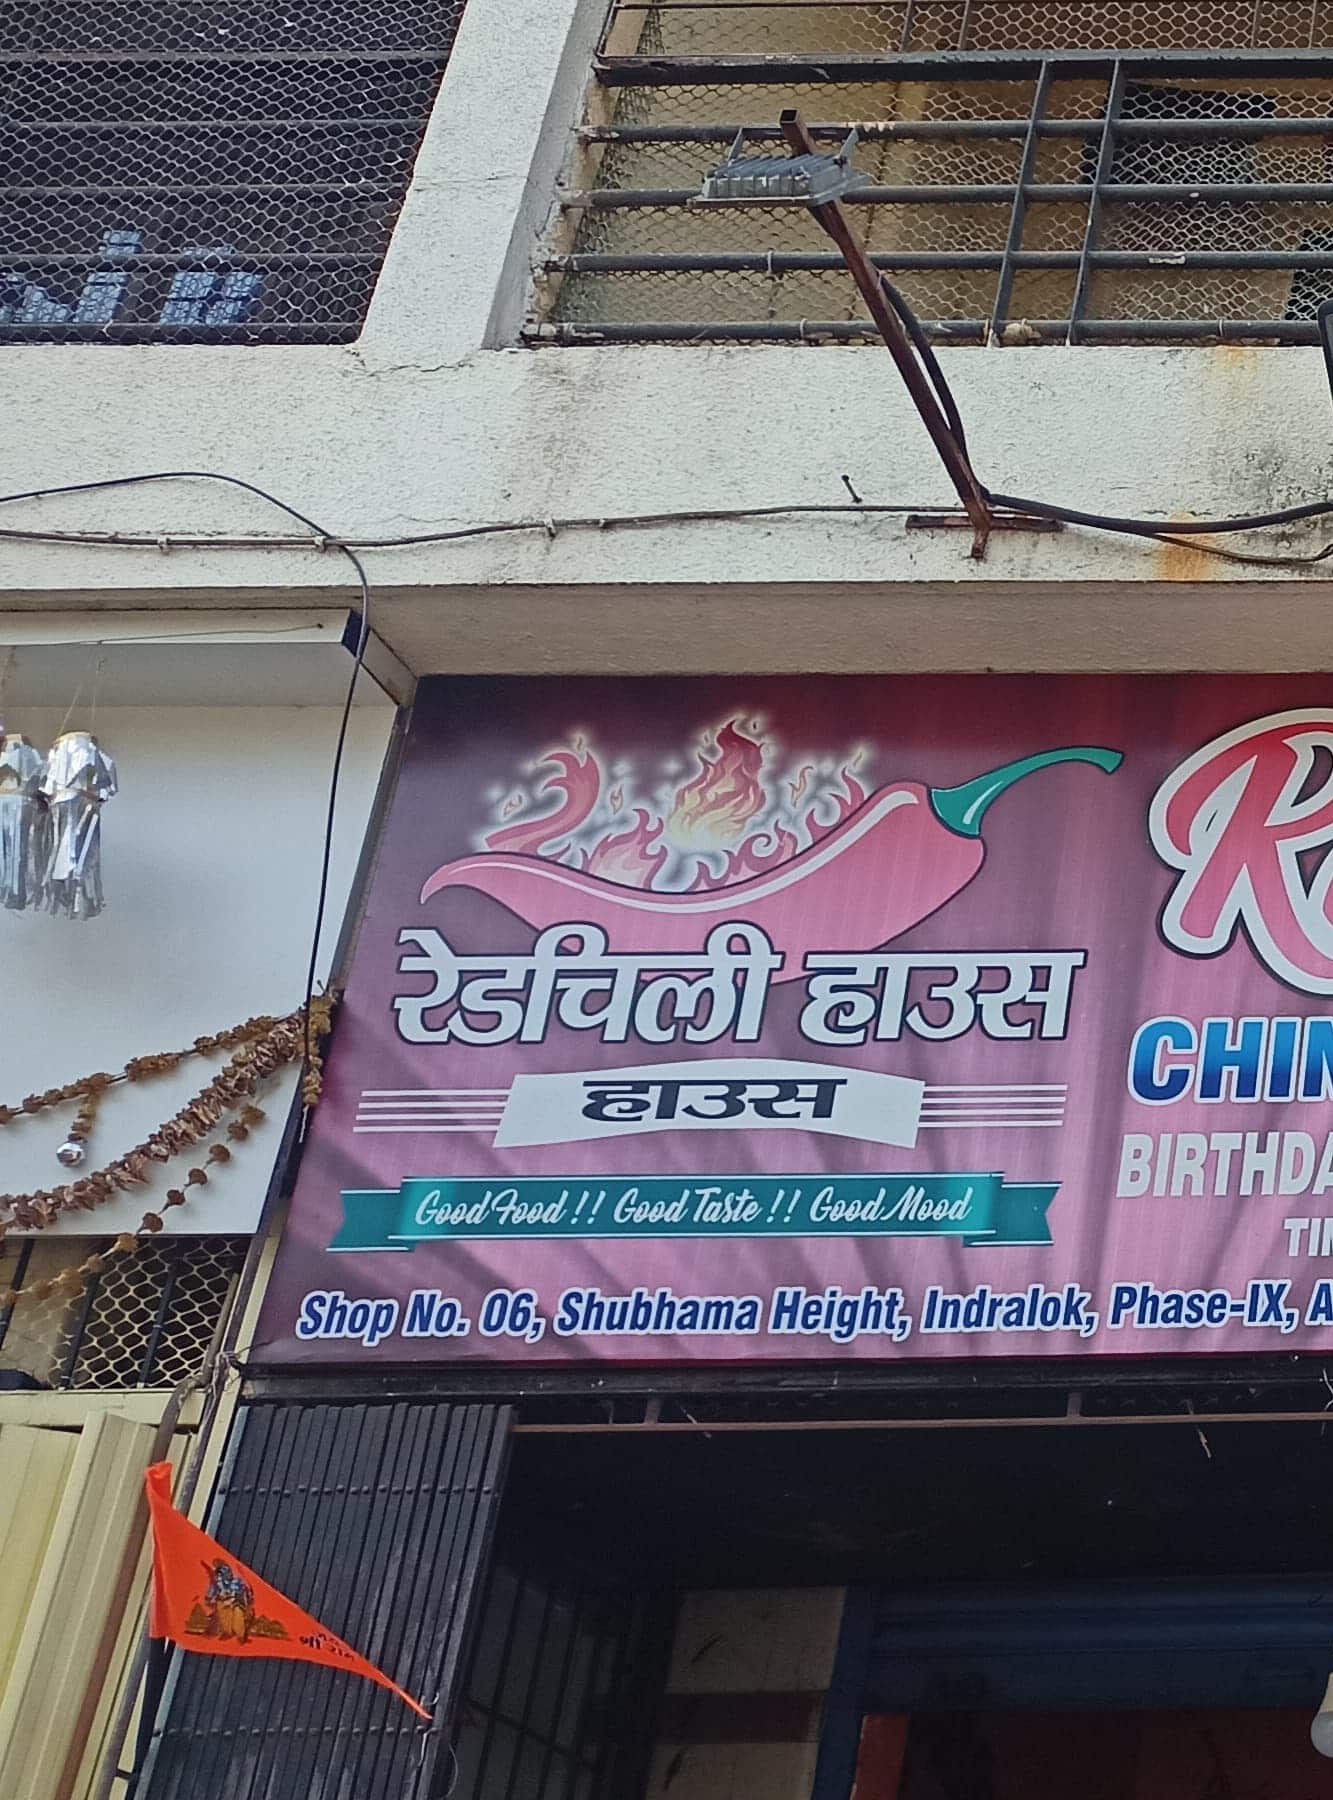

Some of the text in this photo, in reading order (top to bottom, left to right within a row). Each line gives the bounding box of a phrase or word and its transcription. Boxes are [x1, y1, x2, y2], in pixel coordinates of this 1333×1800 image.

[801, 951, 1087, 1047] हाउस
[580, 1079, 848, 1123] हाउस
[415, 1189, 490, 1225] Good
[491, 1189, 568, 1224] Food
[613, 1189, 690, 1223] Good
[692, 1187, 762, 1222] Taste
[809, 1187, 885, 1222] Good
[883, 1187, 974, 1222] Mood
[297, 1290, 399, 1345] Shop
[401, 1291, 470, 1337] No.
[480, 1290, 546, 1342] 06,
[553, 1288, 760, 1337] Shubhama
[768, 1286, 913, 1342] Height,
[920, 1283, 1098, 1336] Indralok,
[1108, 1280, 1298, 1334] Phase-IX,
